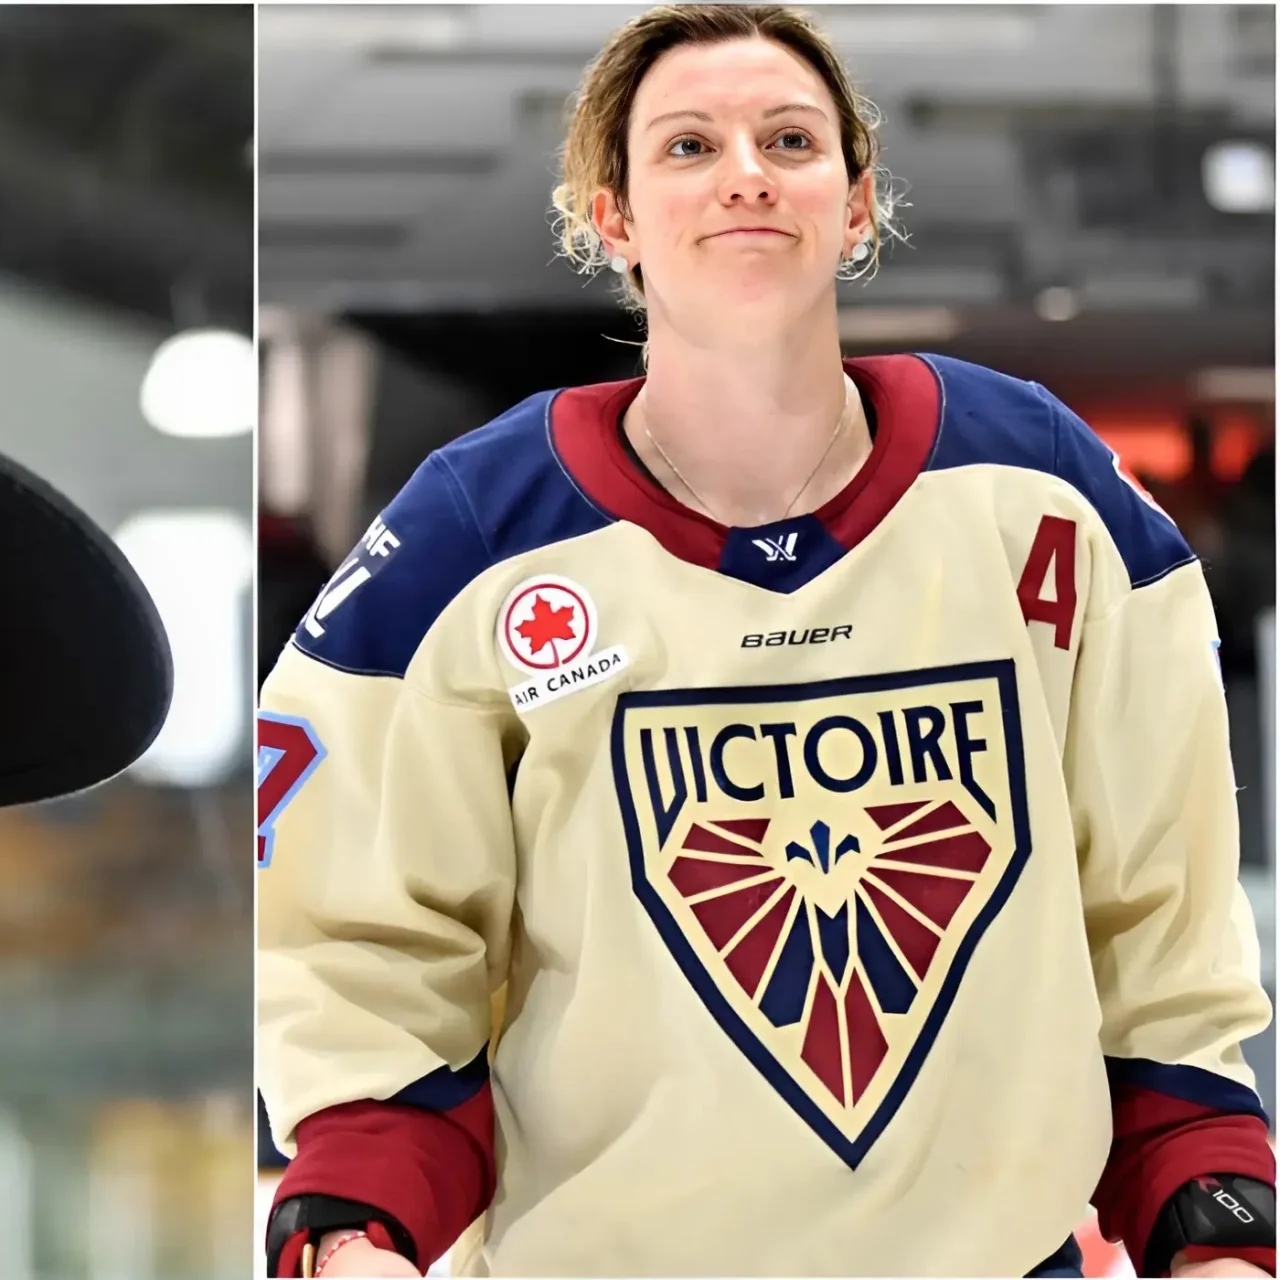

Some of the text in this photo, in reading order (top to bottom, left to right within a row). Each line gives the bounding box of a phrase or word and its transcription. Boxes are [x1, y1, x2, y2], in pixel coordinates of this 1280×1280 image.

[1016, 514, 1078, 651] A
[515, 653, 622, 705] AIR CANADA
[740, 625, 853, 649] BAUER
[639, 699, 997, 854] VICTOIRE
